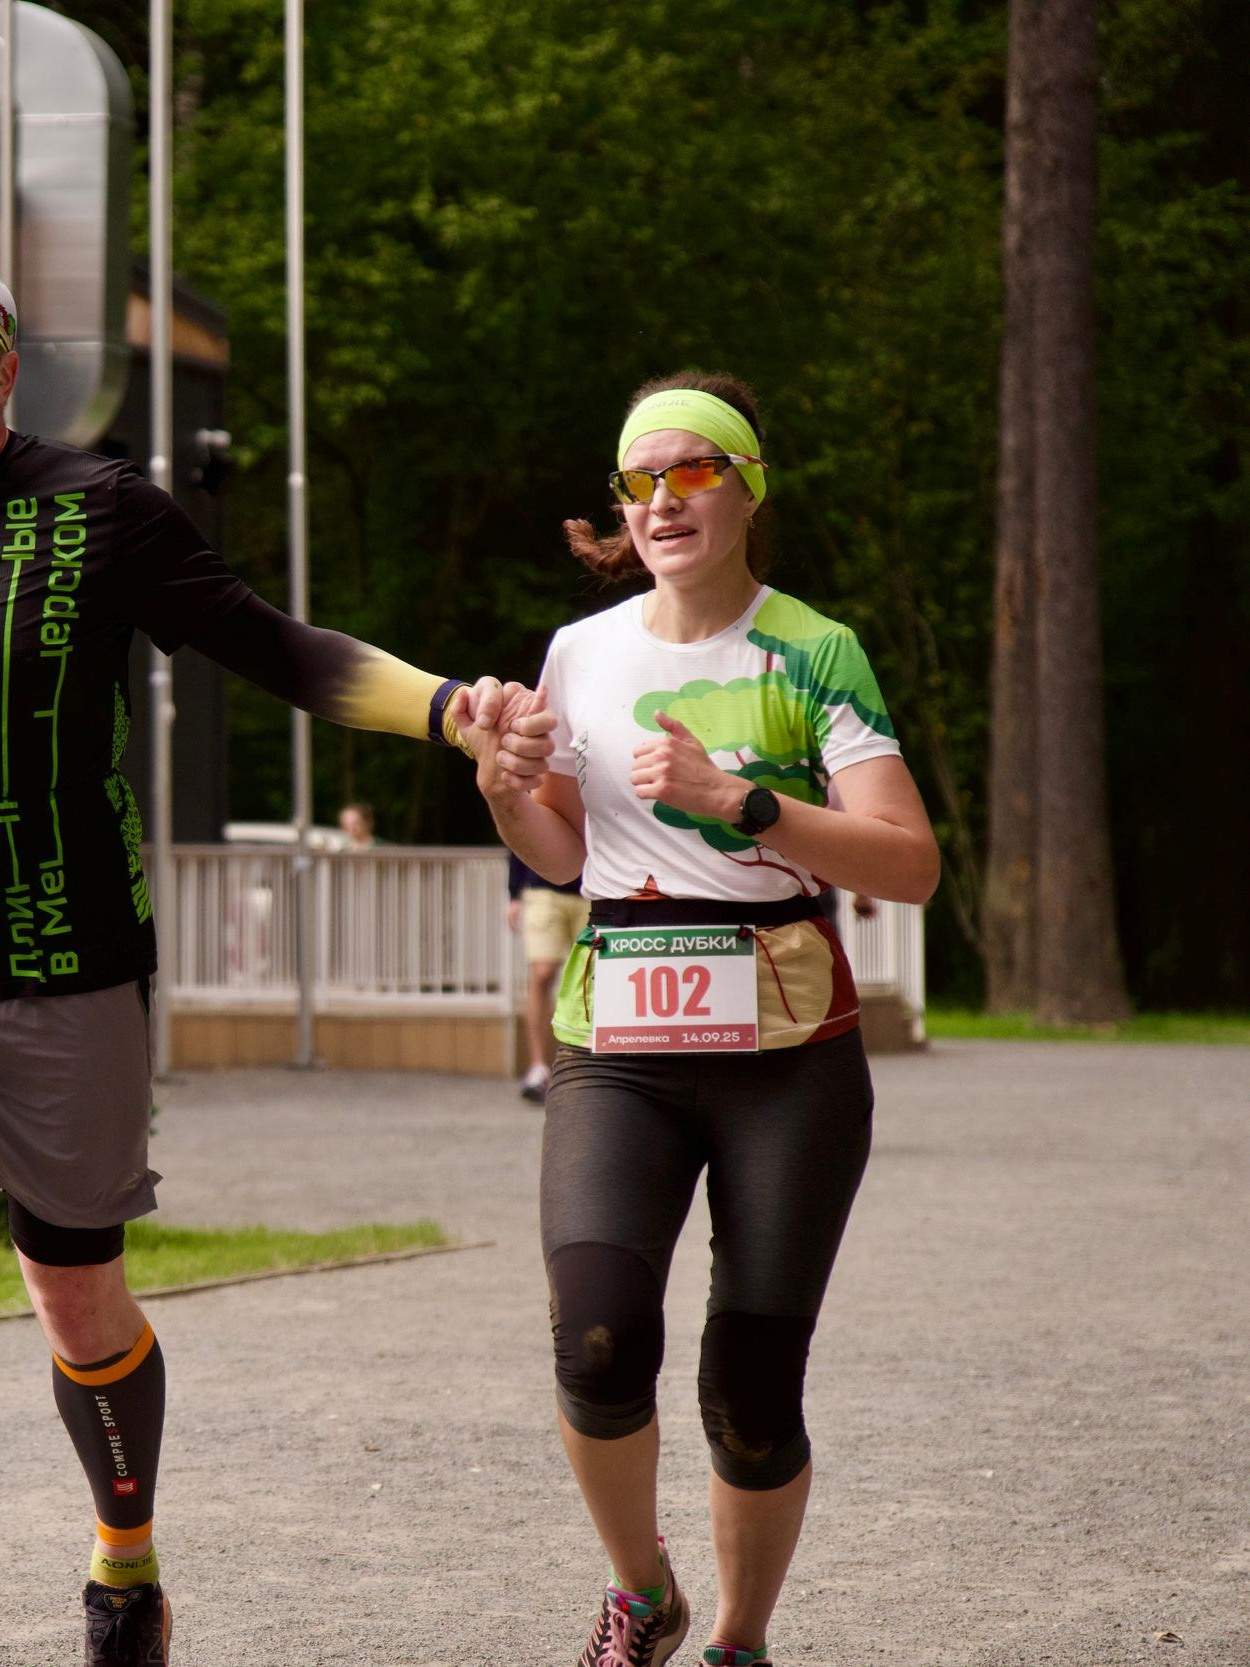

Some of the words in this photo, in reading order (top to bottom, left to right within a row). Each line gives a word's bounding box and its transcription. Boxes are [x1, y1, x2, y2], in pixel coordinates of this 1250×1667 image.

[610, 937, 666, 953] КРОСС
[670, 936, 736, 954] ДУБКИ
[50, 950, 79, 976] в
[628, 965, 711, 1018] 102
[608, 1034, 670, 1045] Апрелевка
[682, 1032, 740, 1043] 14.09.25
[101, 1554, 154, 1569] AONIJIE
